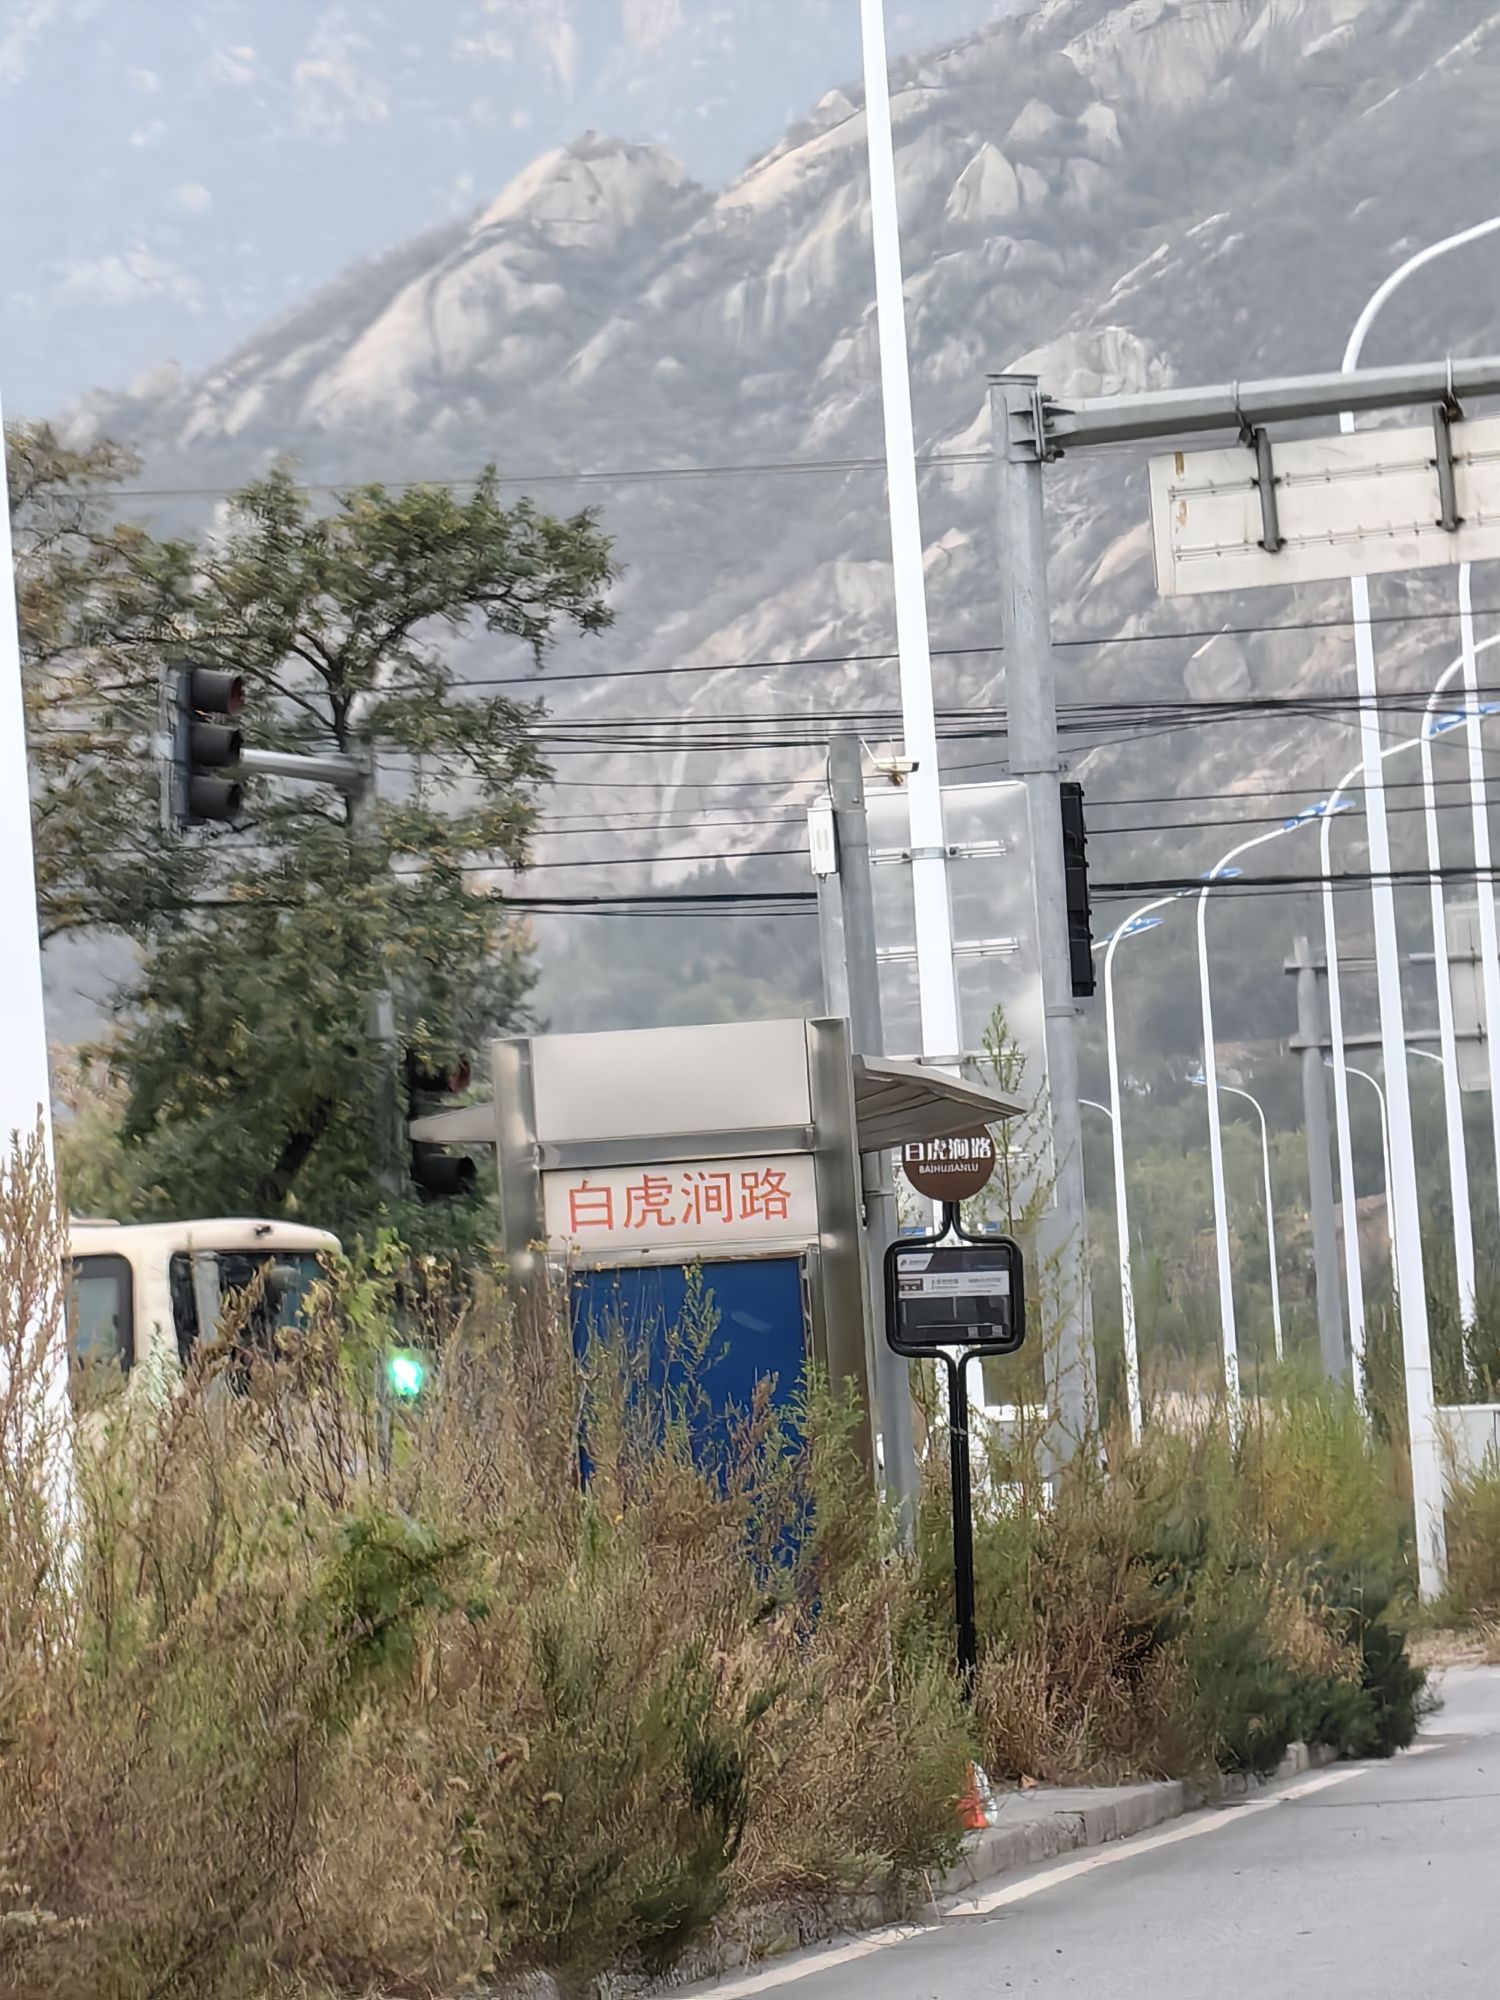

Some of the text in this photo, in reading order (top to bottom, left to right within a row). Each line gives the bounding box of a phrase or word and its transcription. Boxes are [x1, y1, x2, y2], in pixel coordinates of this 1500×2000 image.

[919, 1162, 979, 1174] BAIHUJIANLU
[569, 1167, 791, 1233] 白虎涧路
